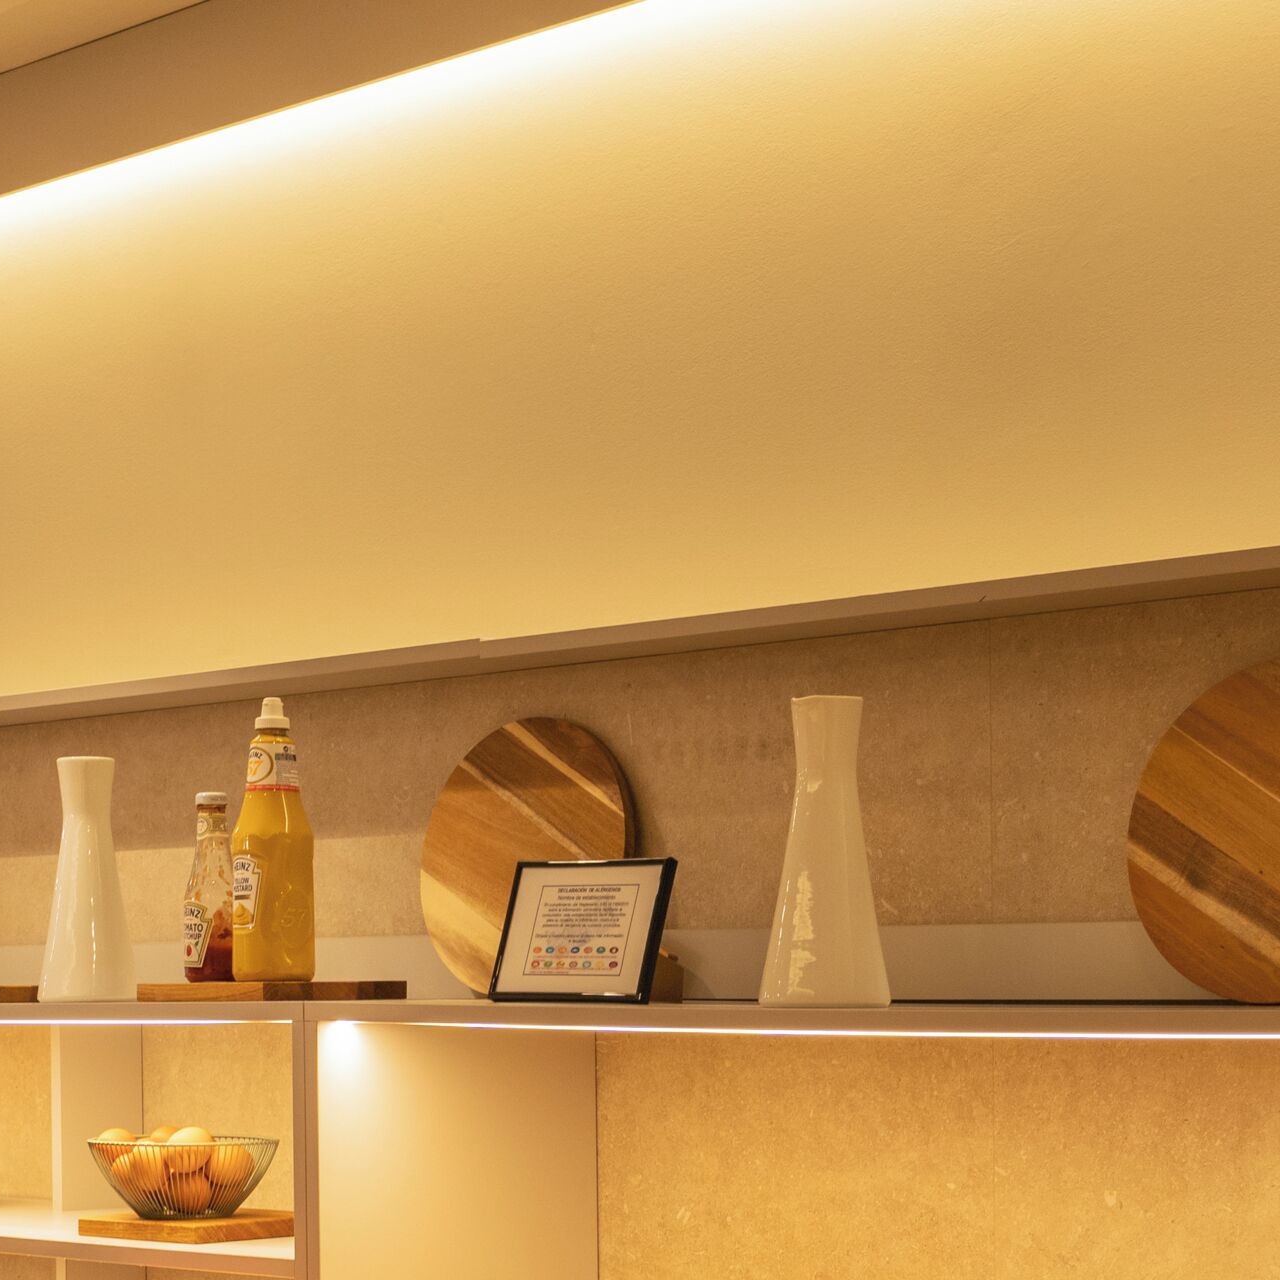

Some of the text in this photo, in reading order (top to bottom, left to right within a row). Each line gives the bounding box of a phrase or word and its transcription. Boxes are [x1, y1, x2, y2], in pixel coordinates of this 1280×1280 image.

[234, 884, 253, 892] STARD
[184, 907, 201, 919] EINZ
[184, 922, 204, 932] MATO
